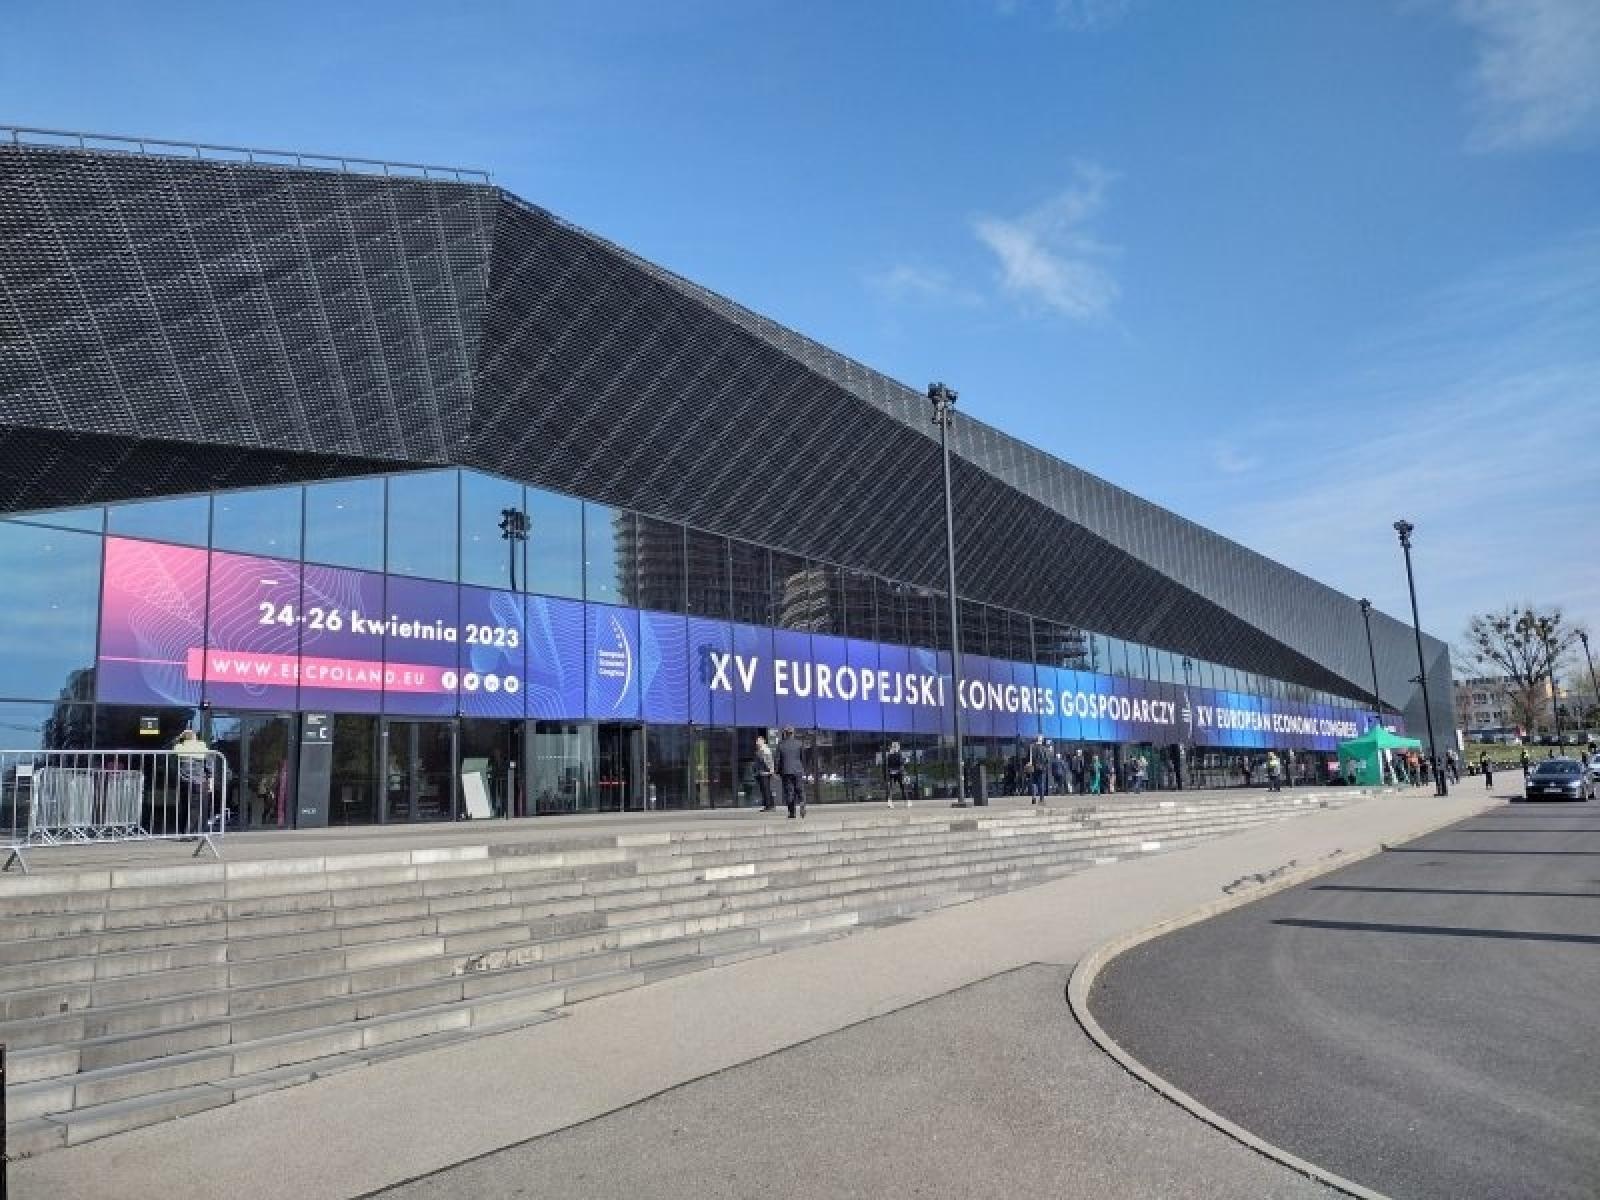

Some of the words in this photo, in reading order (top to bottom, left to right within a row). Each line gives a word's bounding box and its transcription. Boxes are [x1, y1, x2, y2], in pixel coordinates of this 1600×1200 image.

[259, 601, 342, 632] 24-26
[351, 609, 456, 642] kwietnia
[464, 623, 519, 649] 2023
[213, 658, 426, 686] WWW.EECPOLAND.EU
[709, 652, 758, 692] XV
[774, 659, 945, 707] EUROPEJSKI
[1061, 688, 1175, 725] GOSPODARCZY
